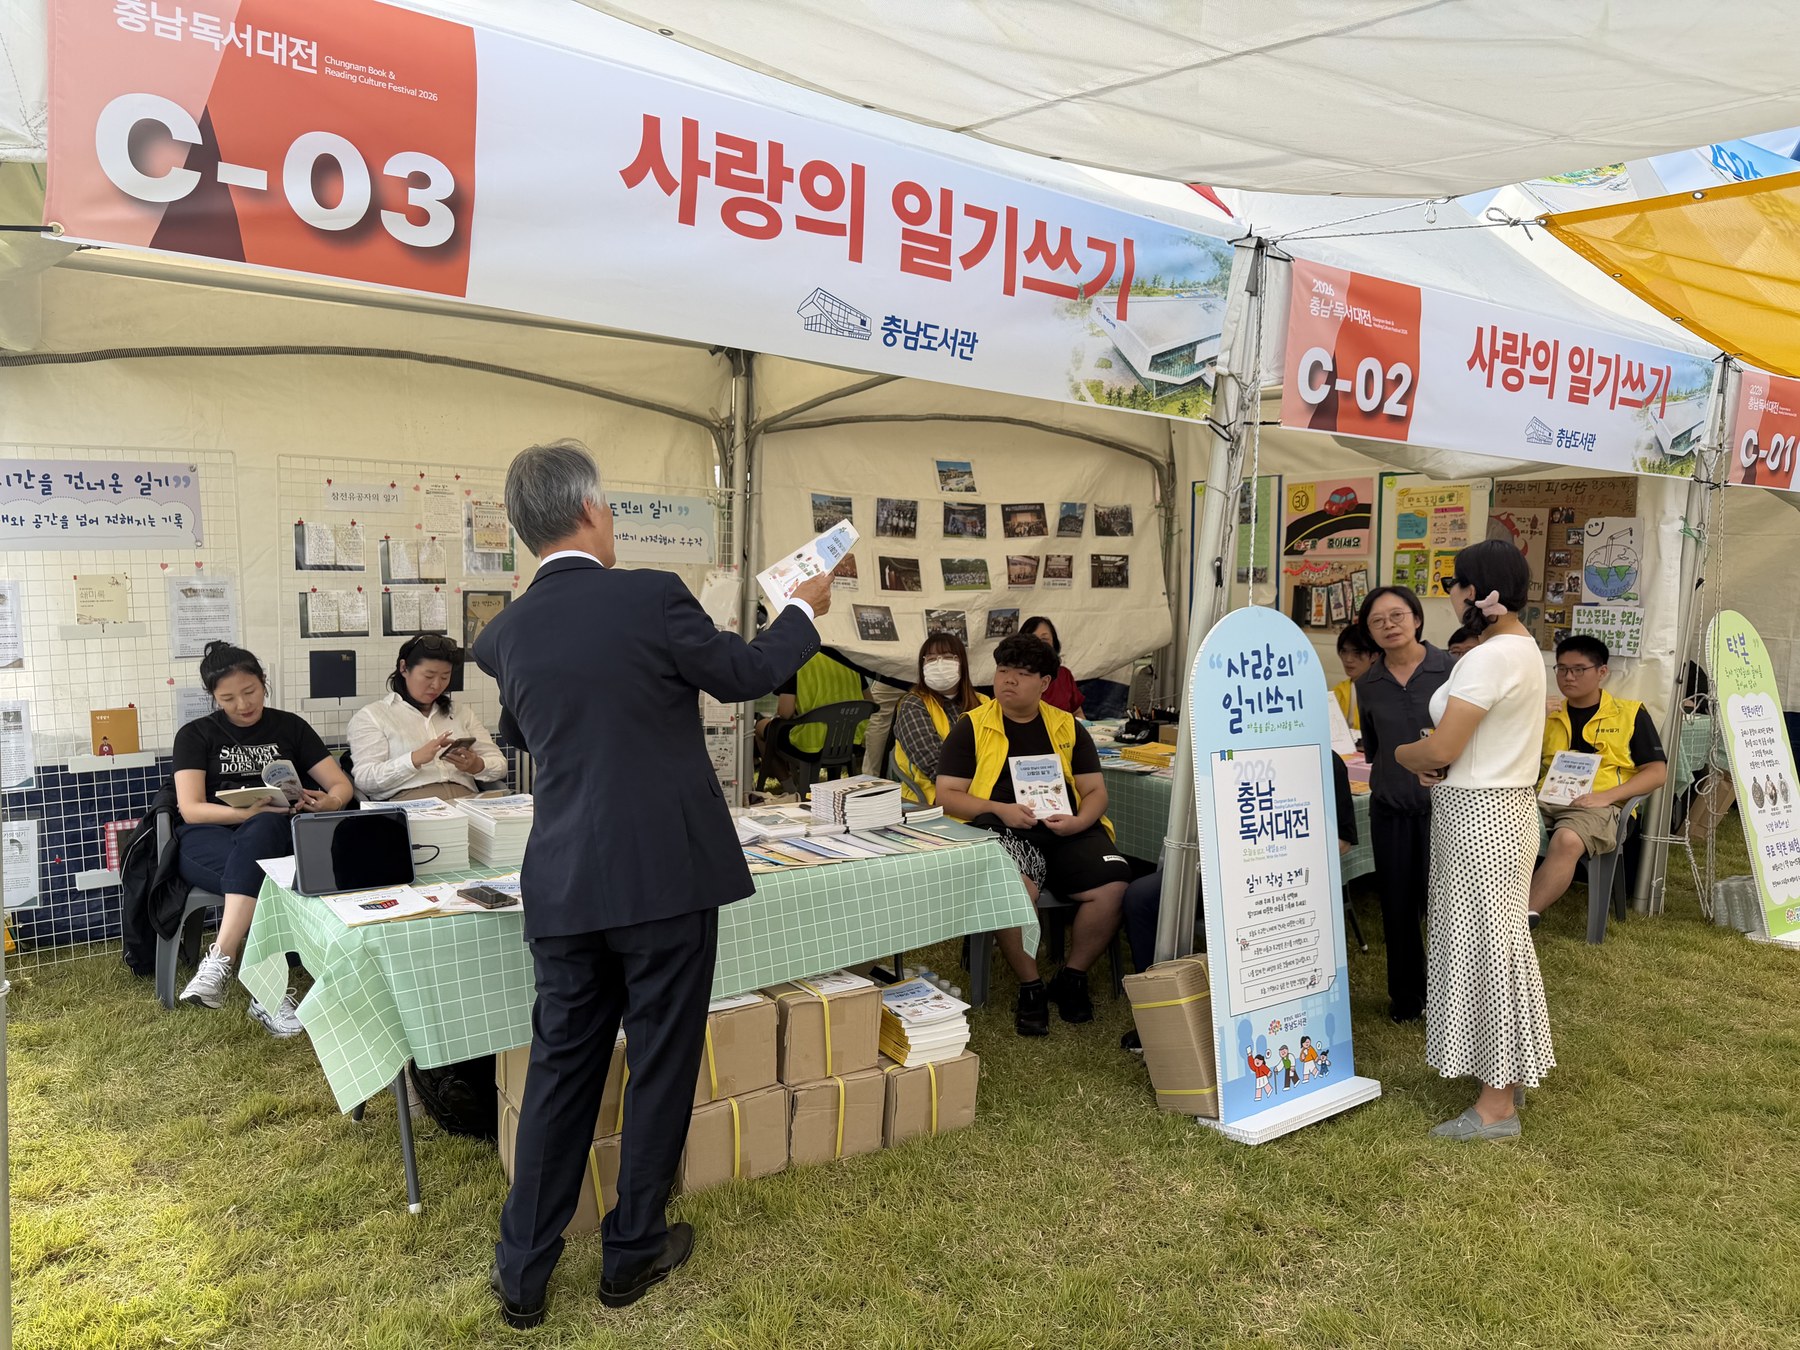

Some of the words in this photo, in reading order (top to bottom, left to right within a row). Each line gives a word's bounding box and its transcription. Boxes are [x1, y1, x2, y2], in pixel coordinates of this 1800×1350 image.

[113, 0, 187, 41] 충남
[189, 12, 318, 75] 독서대전
[324, 55, 367, 73] Chungnam
[367, 64, 388, 78] Book
[388, 70, 396, 80] &
[325, 67, 357, 84] Reading
[357, 74, 387, 89] Culture
[388, 80, 417, 96] Festival
[418, 88, 438, 101] 2026
[95, 92, 456, 248] C-03
[619, 113, 867, 263] 사랑의
[891, 180, 1136, 322] 일기쓰기
[1312, 278, 1335, 297] 2026
[1309, 296, 1334, 319] 충남
[1332, 300, 1373, 327] 독서대전
[880, 315, 979, 362] 충남도서관
[1297, 347, 1413, 418] C-02
[1466, 325, 1560, 400] 사랑의
[1568, 346, 1673, 419] 일기쓰기
[1556, 427, 1597, 452] 충남도서관
[1740, 429, 1796, 473] C-01
[63, 472, 124, 495] 건너온
[383, 494, 398, 502] 일기
[32, 512, 69, 530] 공간을
[75, 514, 99, 528] 넘어
[104, 513, 156, 528] 전해지는
[161, 513, 184, 529] 기록
[613, 533, 637, 541] 기쓰기
[679, 536, 703, 547] 우수작
[1222, 684, 1304, 735] 일기쓰기
[1233, 759, 1277, 786] 2026
[1237, 779, 1276, 815] 충남
[1238, 807, 1310, 845] 독서대전
[1246, 874, 1262, 894] 일기
[1265, 872, 1283, 888] 작성
[1286, 868, 1303, 885] 주제
[1283, 1017, 1308, 1033] 충남도서관
